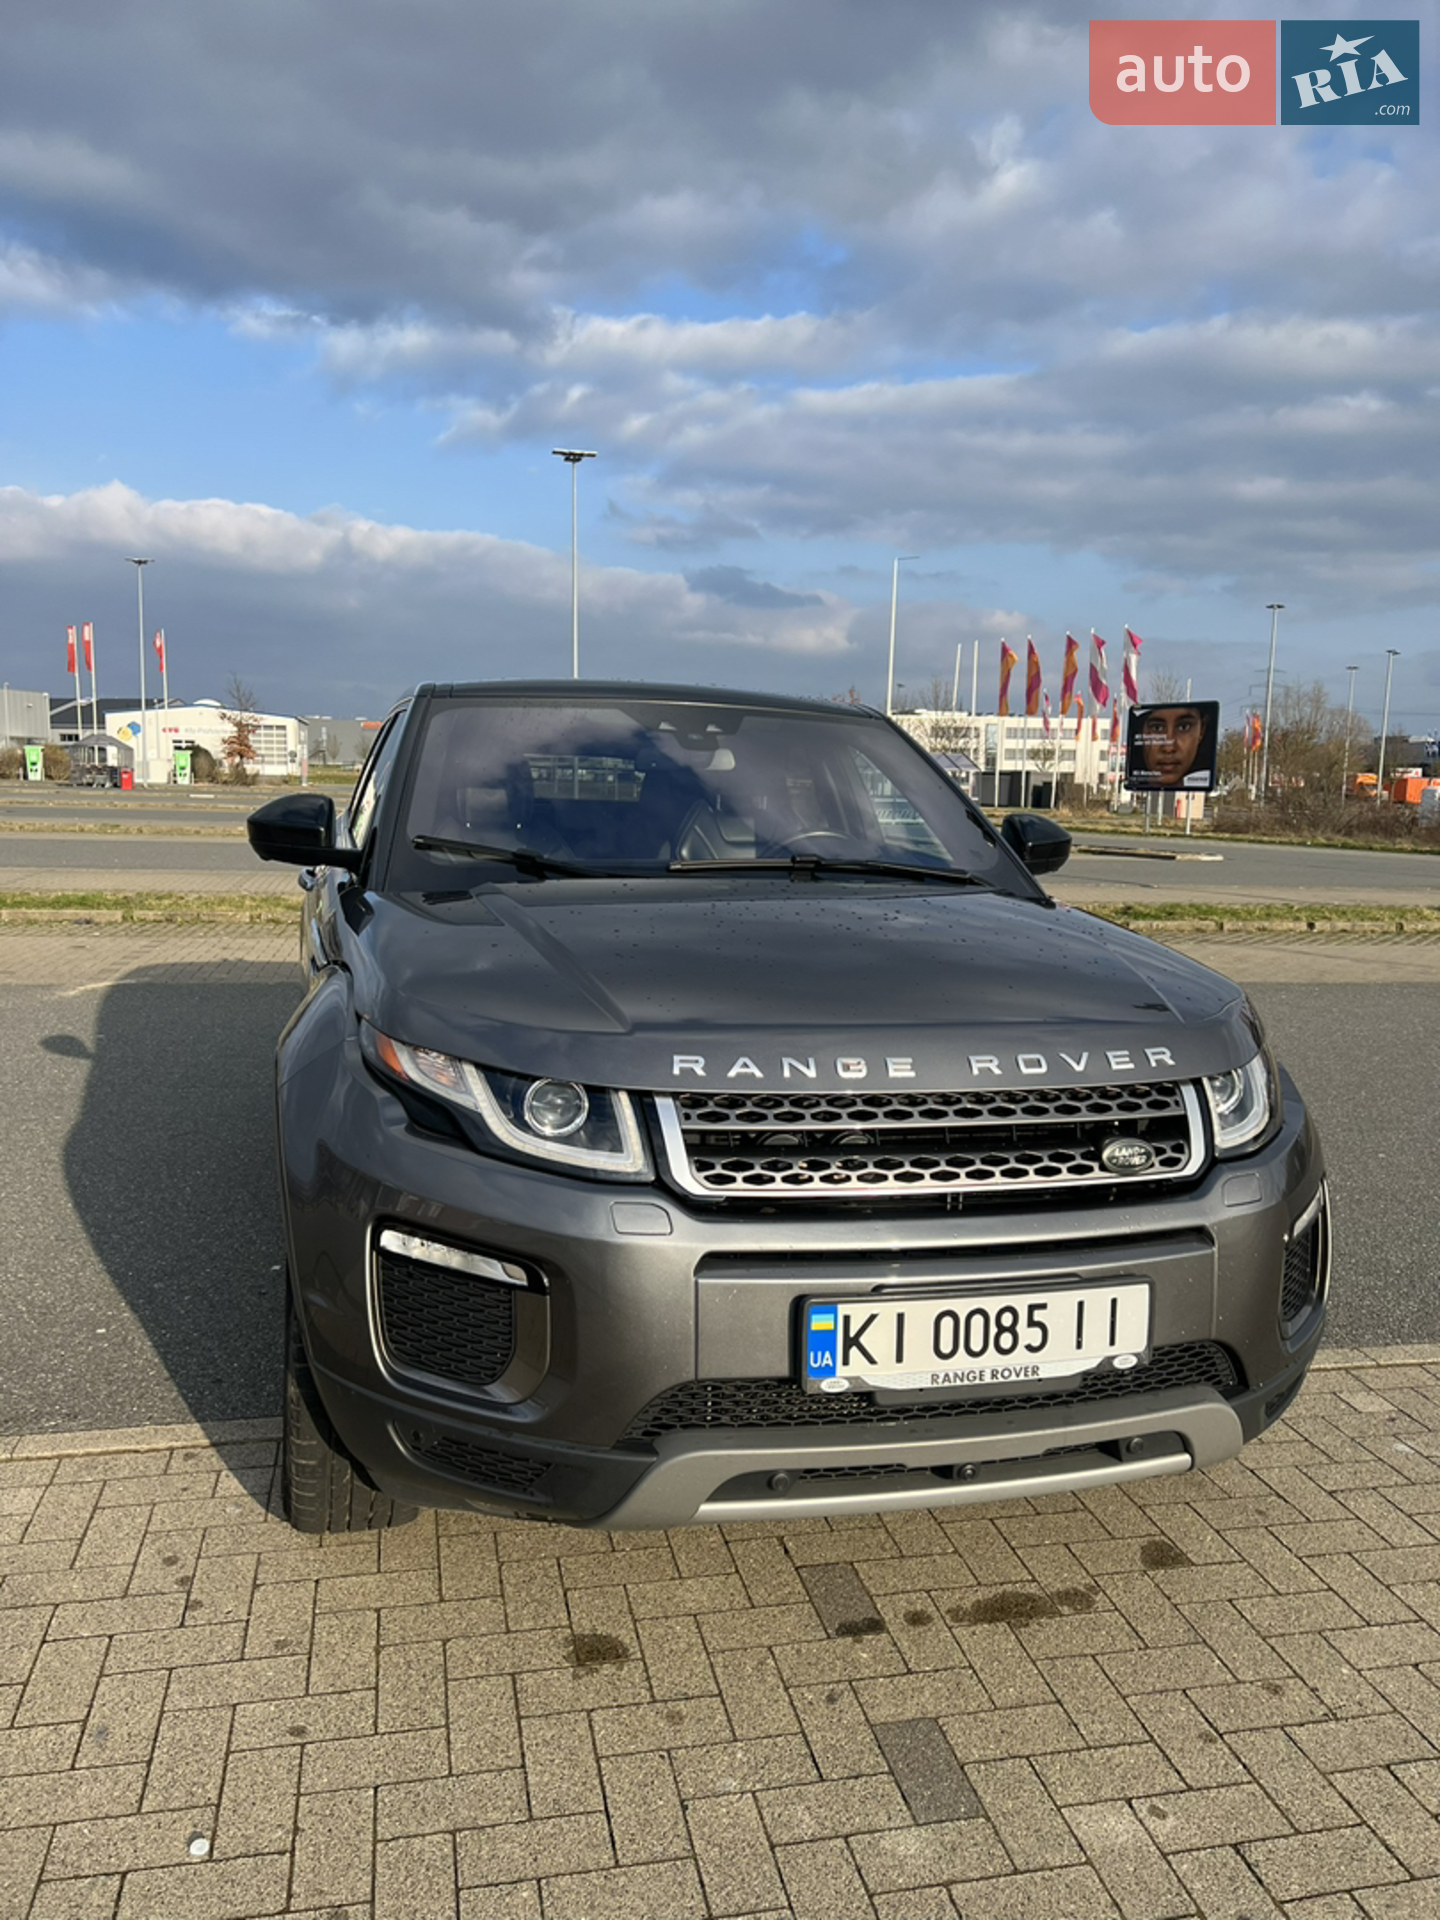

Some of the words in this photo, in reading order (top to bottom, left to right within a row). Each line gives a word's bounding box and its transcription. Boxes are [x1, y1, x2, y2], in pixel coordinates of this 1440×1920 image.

[672, 1054, 917, 1079] RANGE
[968, 1046, 1176, 1076] ROVER
[1114, 1146, 1141, 1156] LAND
[1118, 1155, 1148, 1166] ROVER
[841, 1312, 906, 1367] KI
[932, 1302, 1049, 1361] 0085
[810, 1350, 833, 1368] UA
[930, 1369, 986, 1386] RANGE
[990, 1365, 1041, 1381] ROVER
